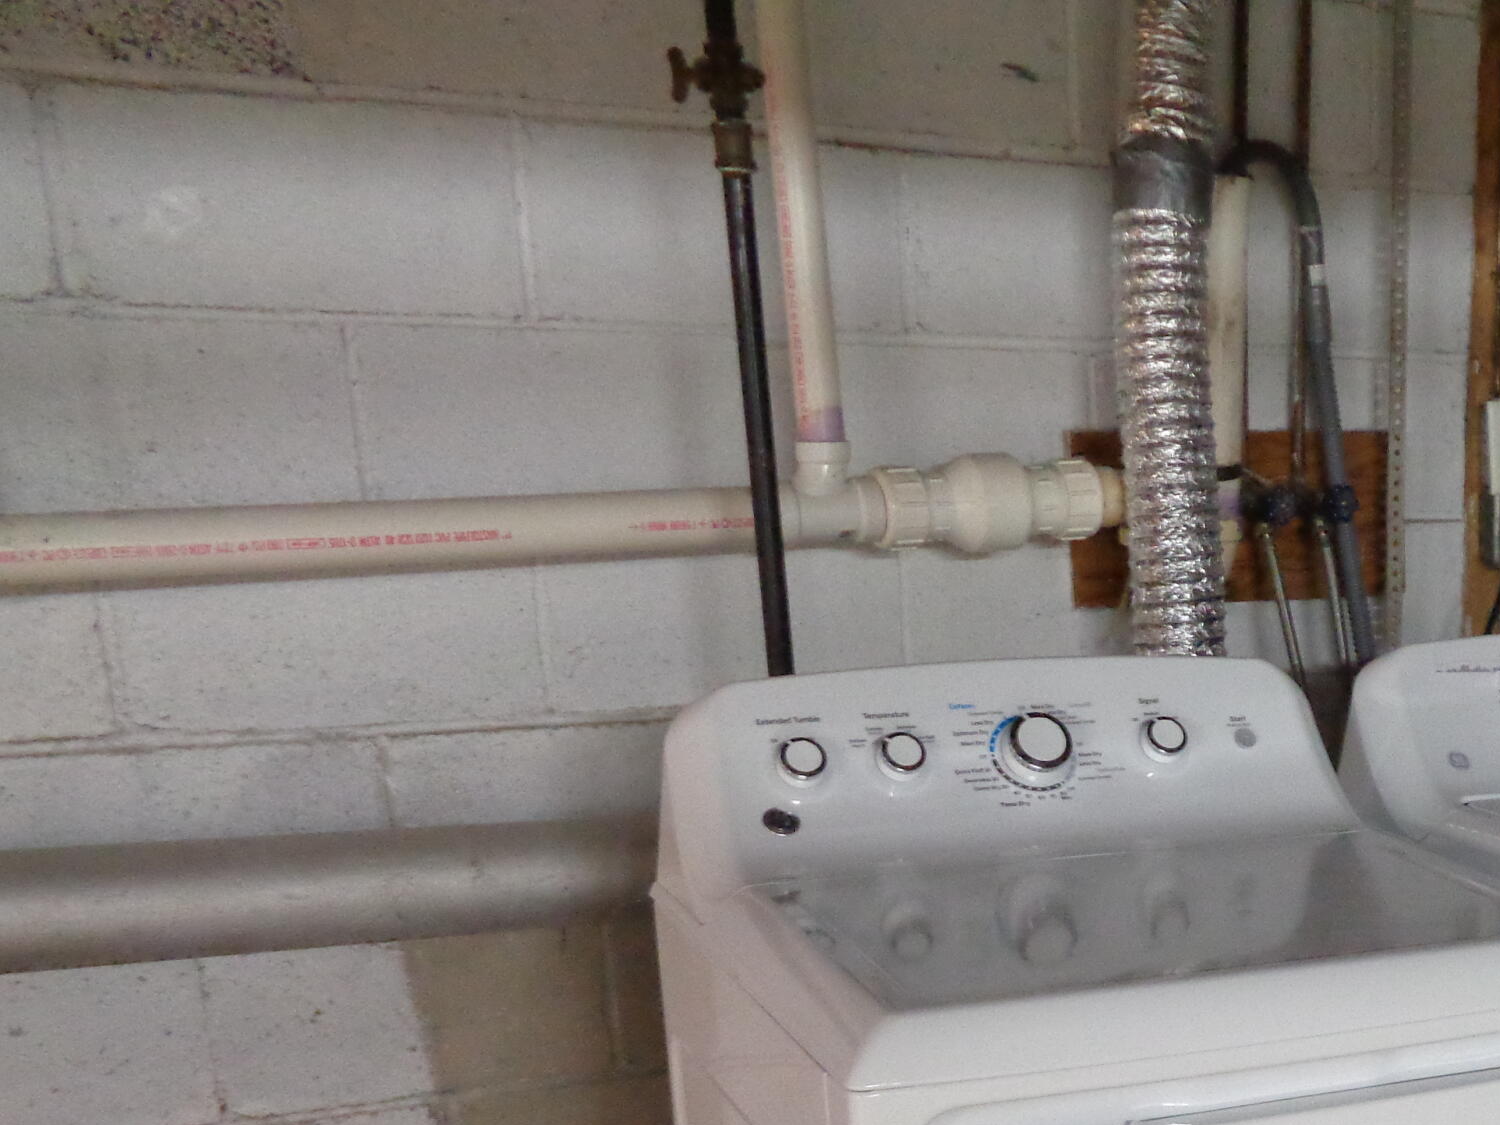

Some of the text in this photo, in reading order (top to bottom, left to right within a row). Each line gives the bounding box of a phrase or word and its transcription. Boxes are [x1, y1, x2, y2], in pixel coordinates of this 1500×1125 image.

[756, 715, 820, 726] Extended Tumble
[863, 711, 910, 720] Temperature
